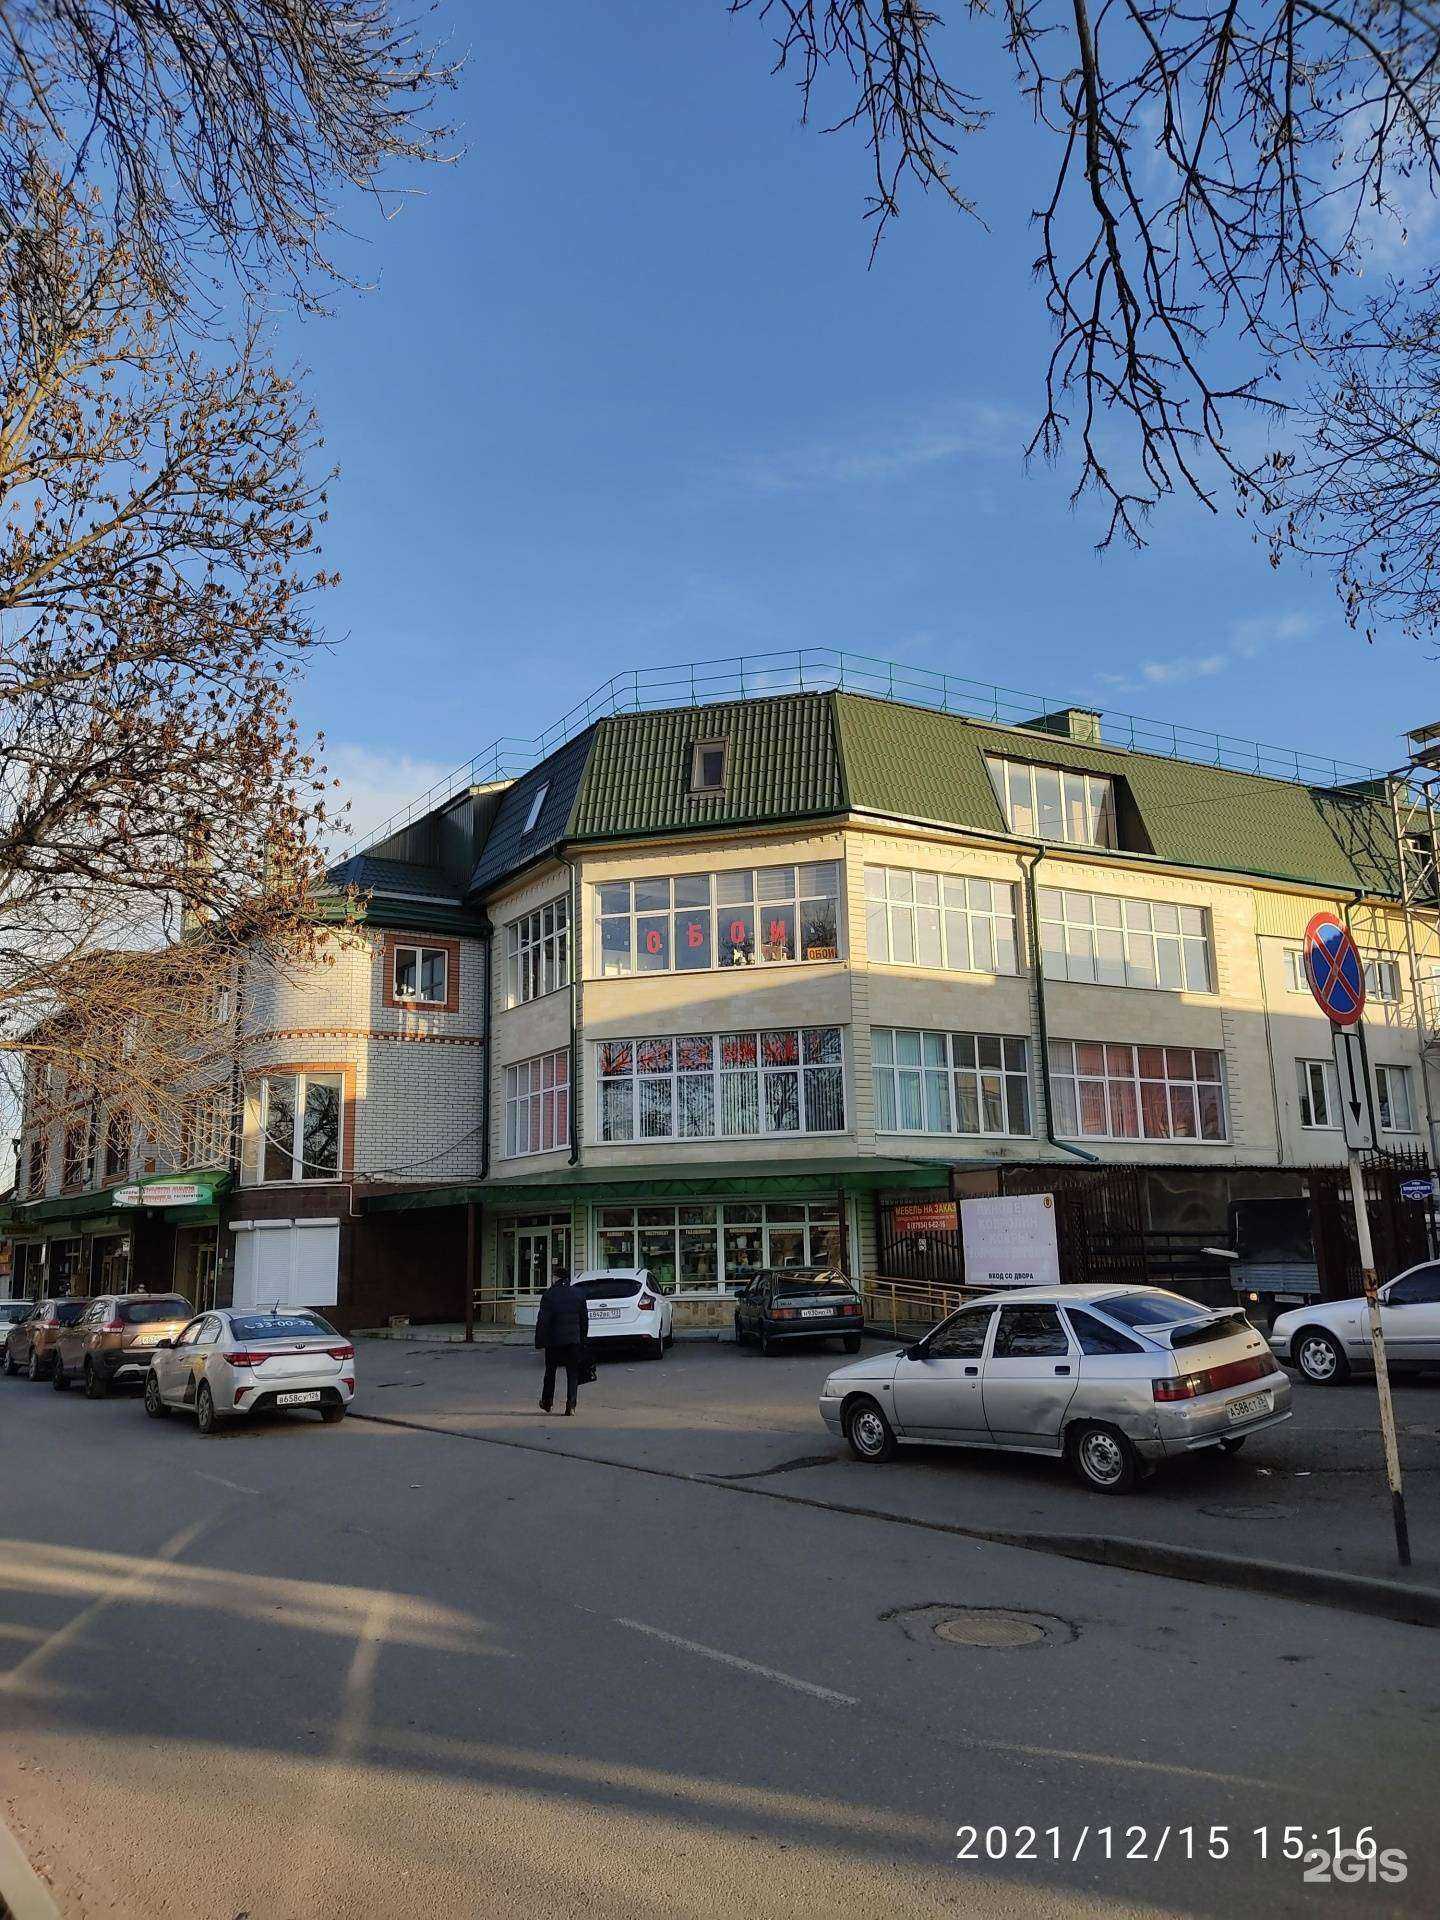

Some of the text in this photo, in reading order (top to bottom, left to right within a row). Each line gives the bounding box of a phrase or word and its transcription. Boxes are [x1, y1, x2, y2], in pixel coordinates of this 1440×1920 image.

[808, 947, 836, 960] ОБОИ
[895, 1201, 957, 1216] МЕБЕЛЬ НА ЗАКАЗ
[988, 1272, 1034, 1281] ВХОД СО ДВОРА
